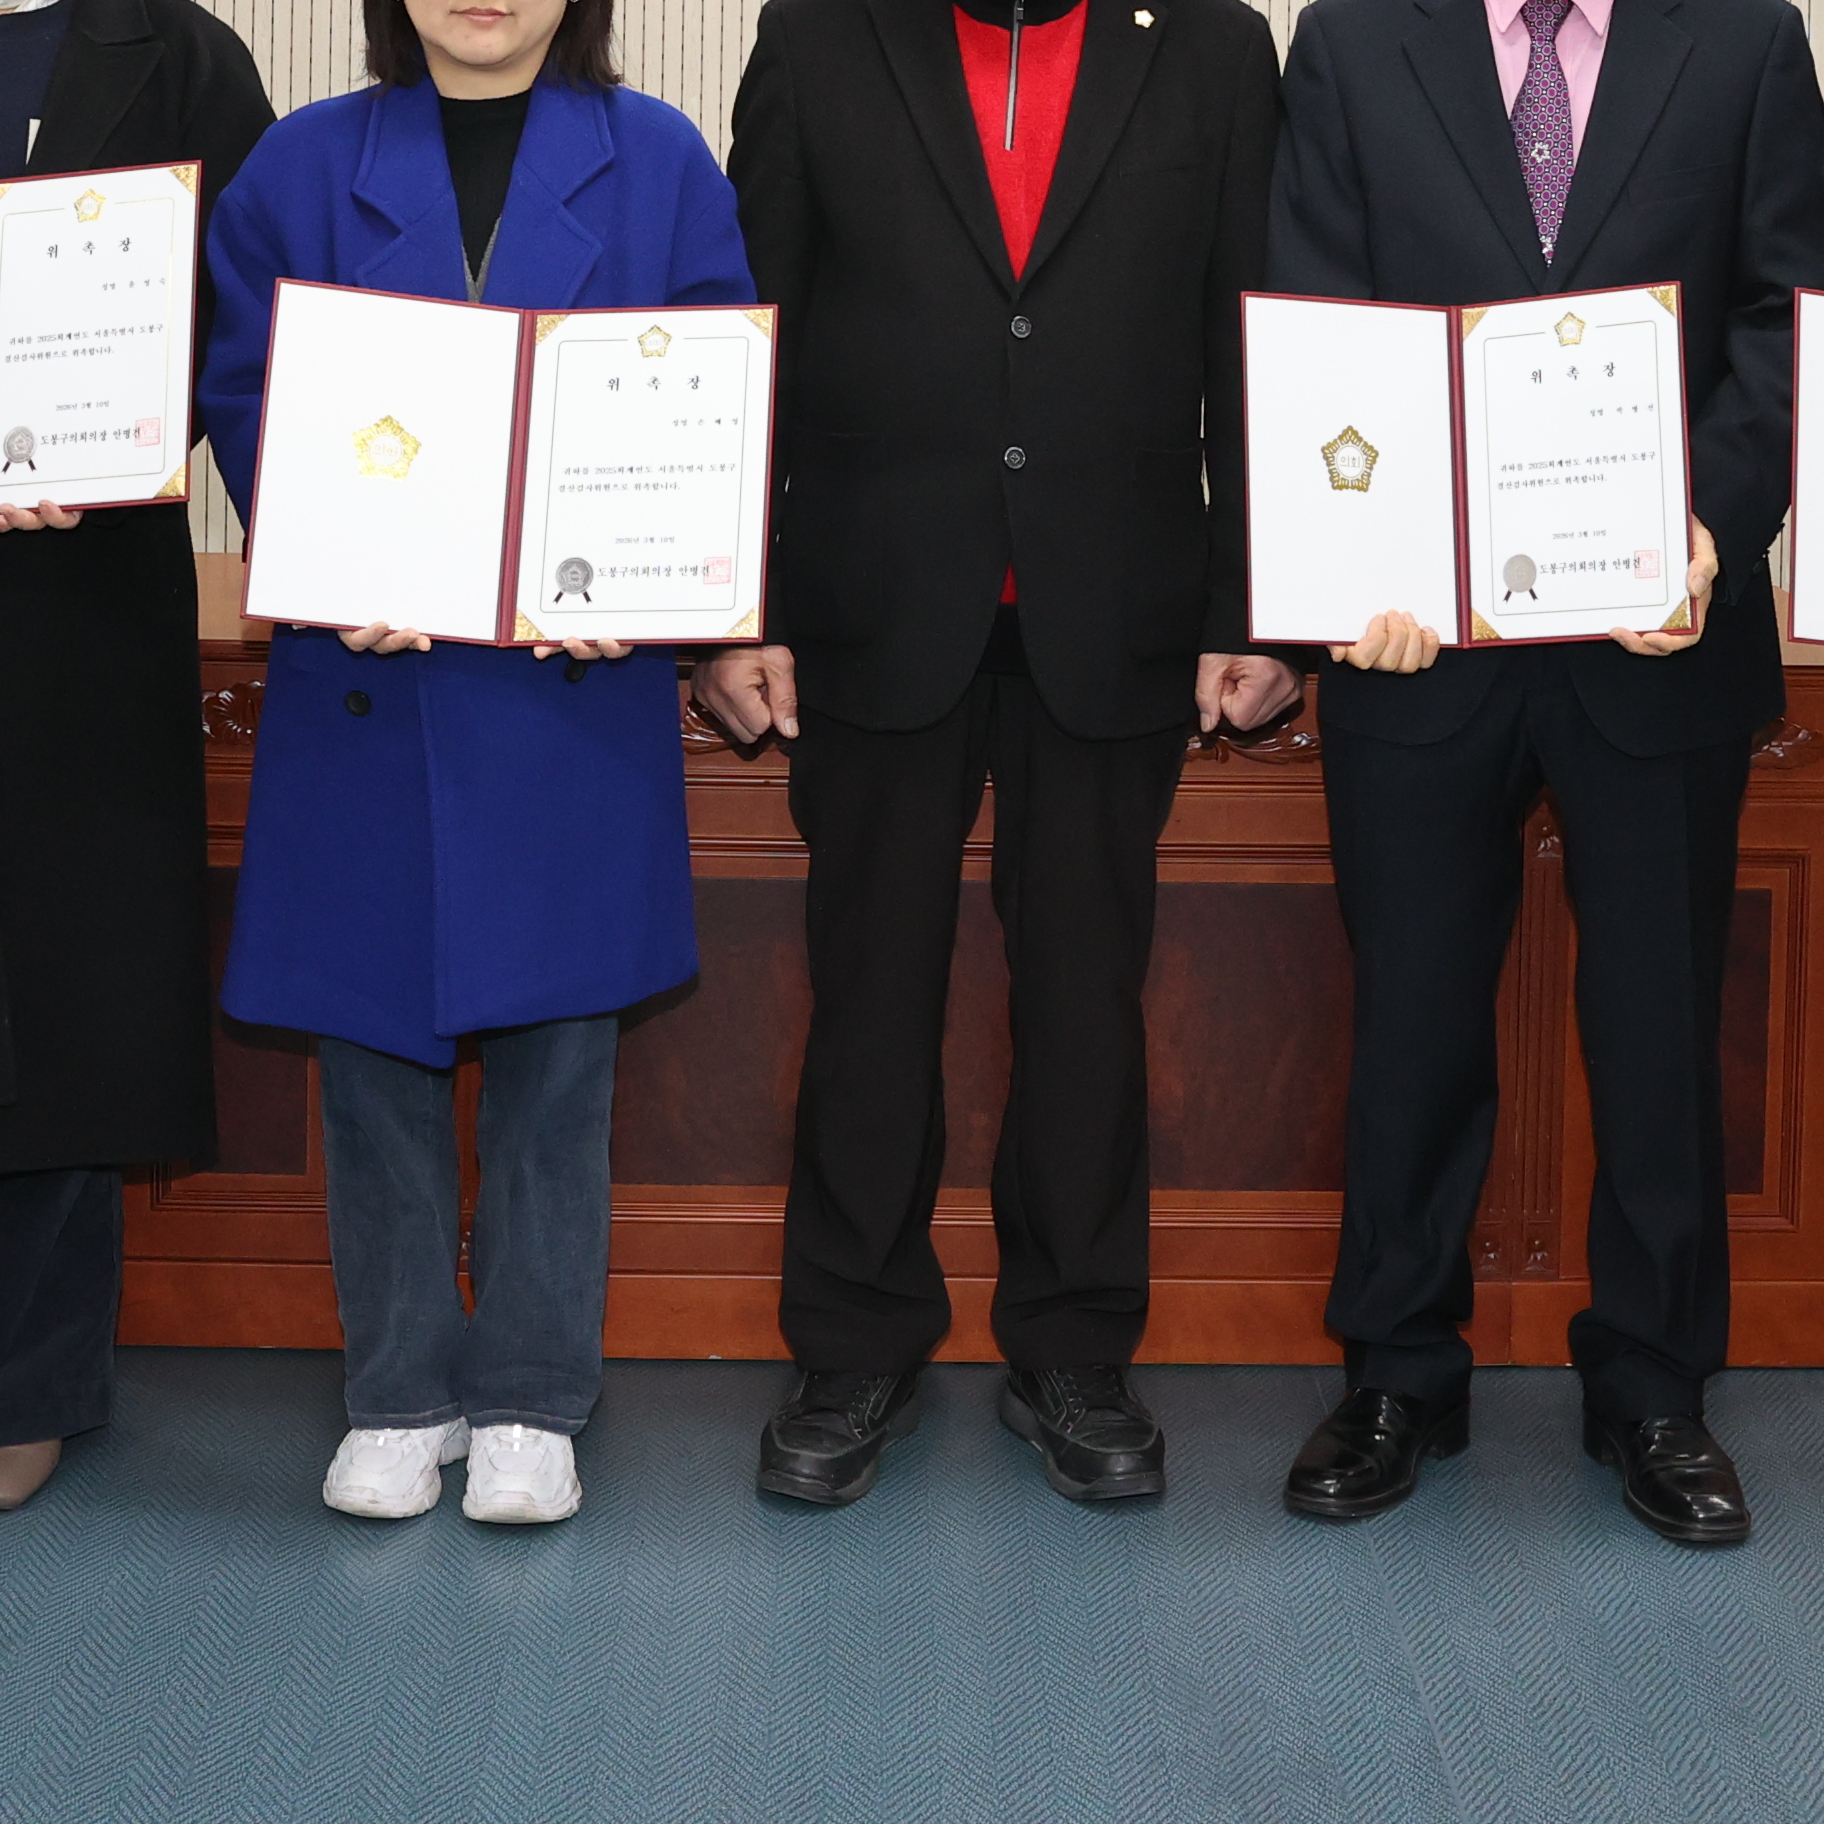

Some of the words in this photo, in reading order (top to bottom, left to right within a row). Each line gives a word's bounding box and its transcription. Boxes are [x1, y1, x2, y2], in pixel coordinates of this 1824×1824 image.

[139, 323, 164, 334] 도봉구
[1631, 451, 1656, 462] 도봉구
[709, 463, 736, 473] 도봉구
